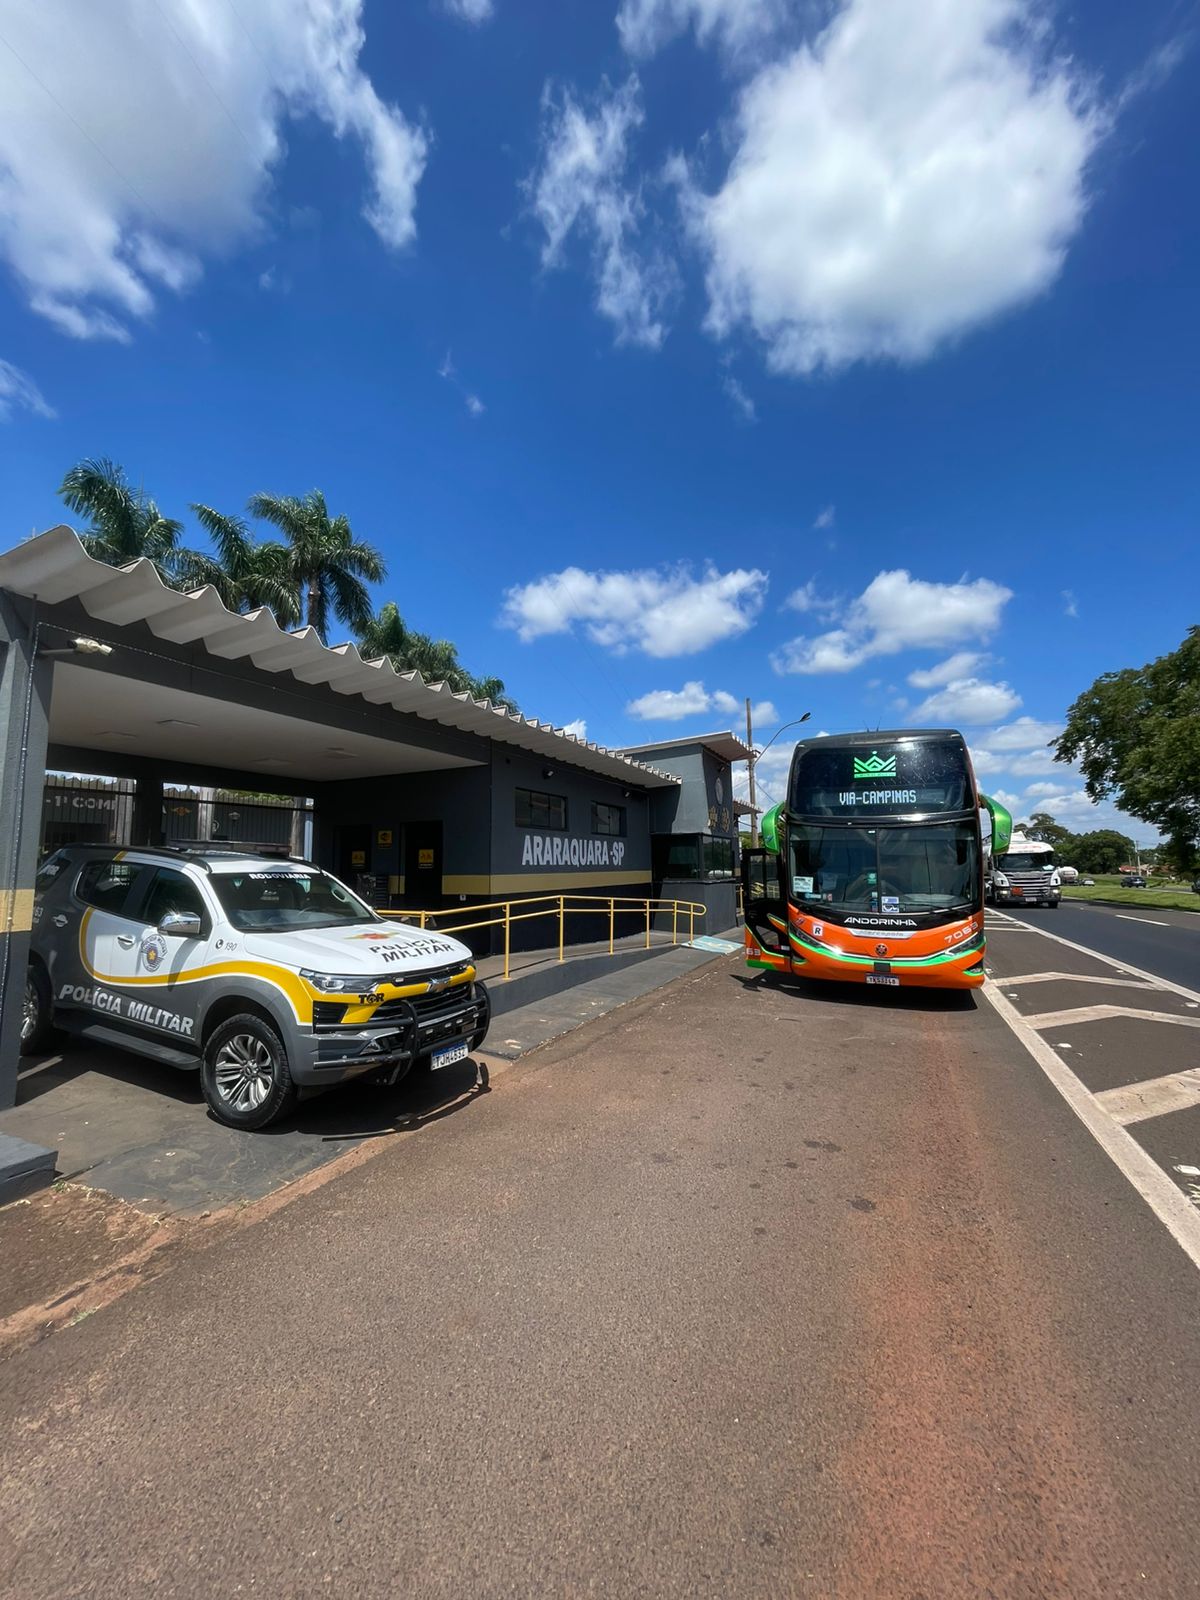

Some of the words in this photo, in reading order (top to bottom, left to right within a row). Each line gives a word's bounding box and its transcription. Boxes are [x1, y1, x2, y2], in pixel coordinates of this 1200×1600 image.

[839, 790, 917, 806] VIA-CAMPINAS
[843, 916, 918, 927] ANDORINHA
[814, 927, 821, 935] R
[225, 942, 237, 951] 190
[381, 943, 455, 962] MILITAR
[358, 992, 385, 1004] TOR
[59, 984, 121, 1014] POLÍCIA
[127, 1001, 194, 1034] MILITAR
